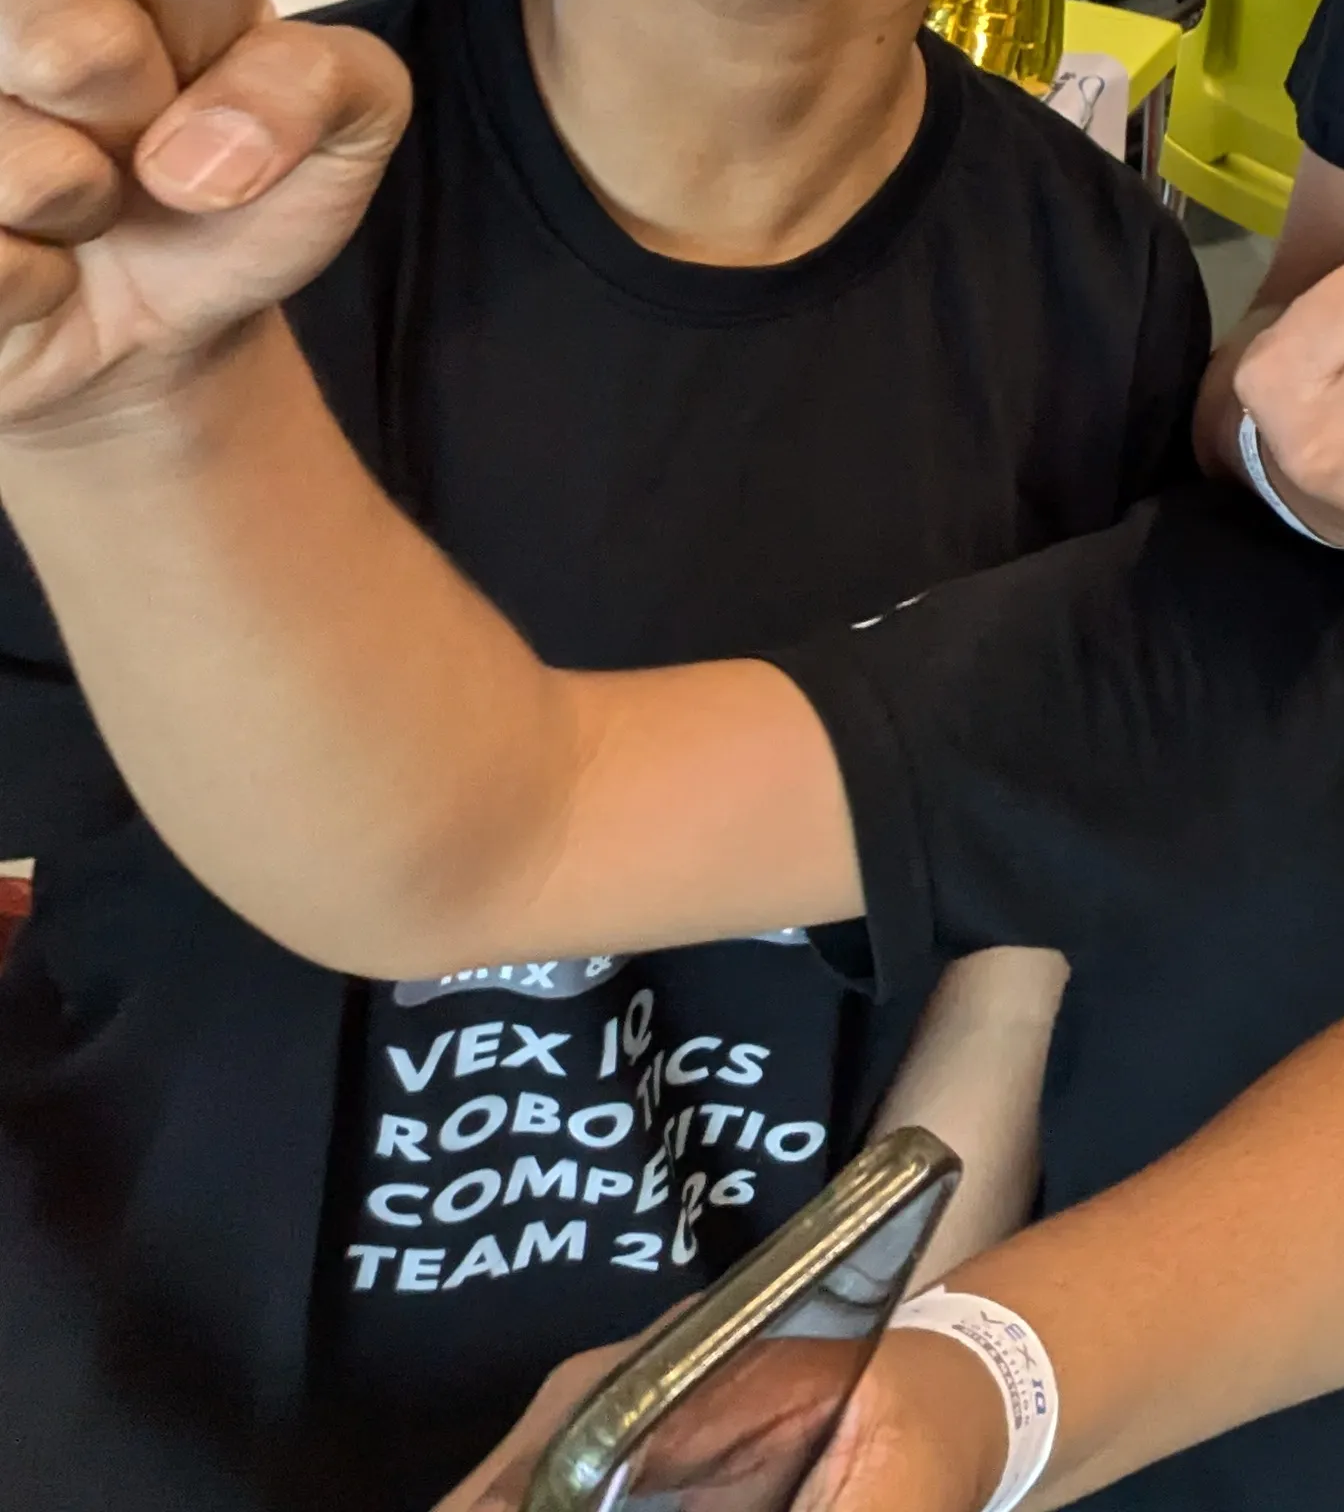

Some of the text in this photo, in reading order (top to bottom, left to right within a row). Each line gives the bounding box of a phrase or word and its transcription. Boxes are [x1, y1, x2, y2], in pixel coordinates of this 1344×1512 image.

[388, 989, 654, 1093] VEX IQ
[375, 1036, 771, 1162] ROBOTICS
[347, 1220, 588, 1292] TEAM
[980, 1310, 1037, 1370] VEX
